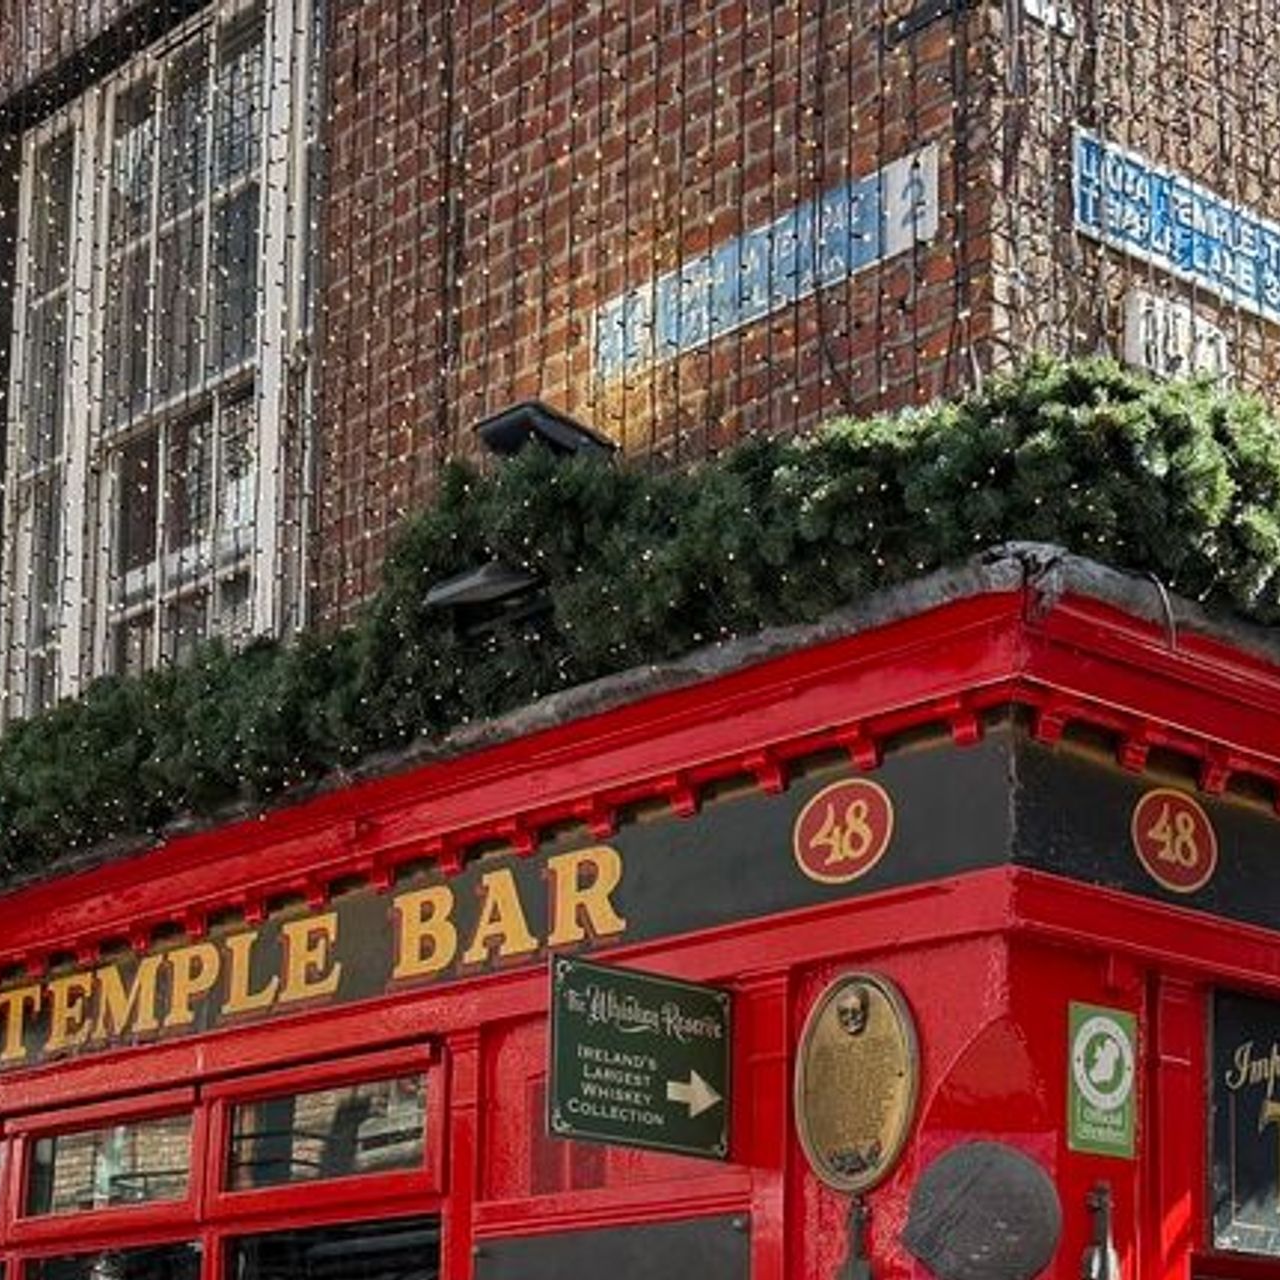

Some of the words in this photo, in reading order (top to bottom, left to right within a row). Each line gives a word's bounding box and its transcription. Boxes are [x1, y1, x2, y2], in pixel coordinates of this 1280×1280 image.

[809, 800, 875, 868] 48
[1149, 803, 1197, 868] 48
[393, 845, 626, 979] BAR
[661, 1001, 723, 1043] Reserve
[577, 1043, 657, 1072] IRELAND'S
[583, 1063, 651, 1086] LARGEST
[581, 1081, 653, 1105] WHISKEY
[568, 1098, 665, 1126] COLLECTION
